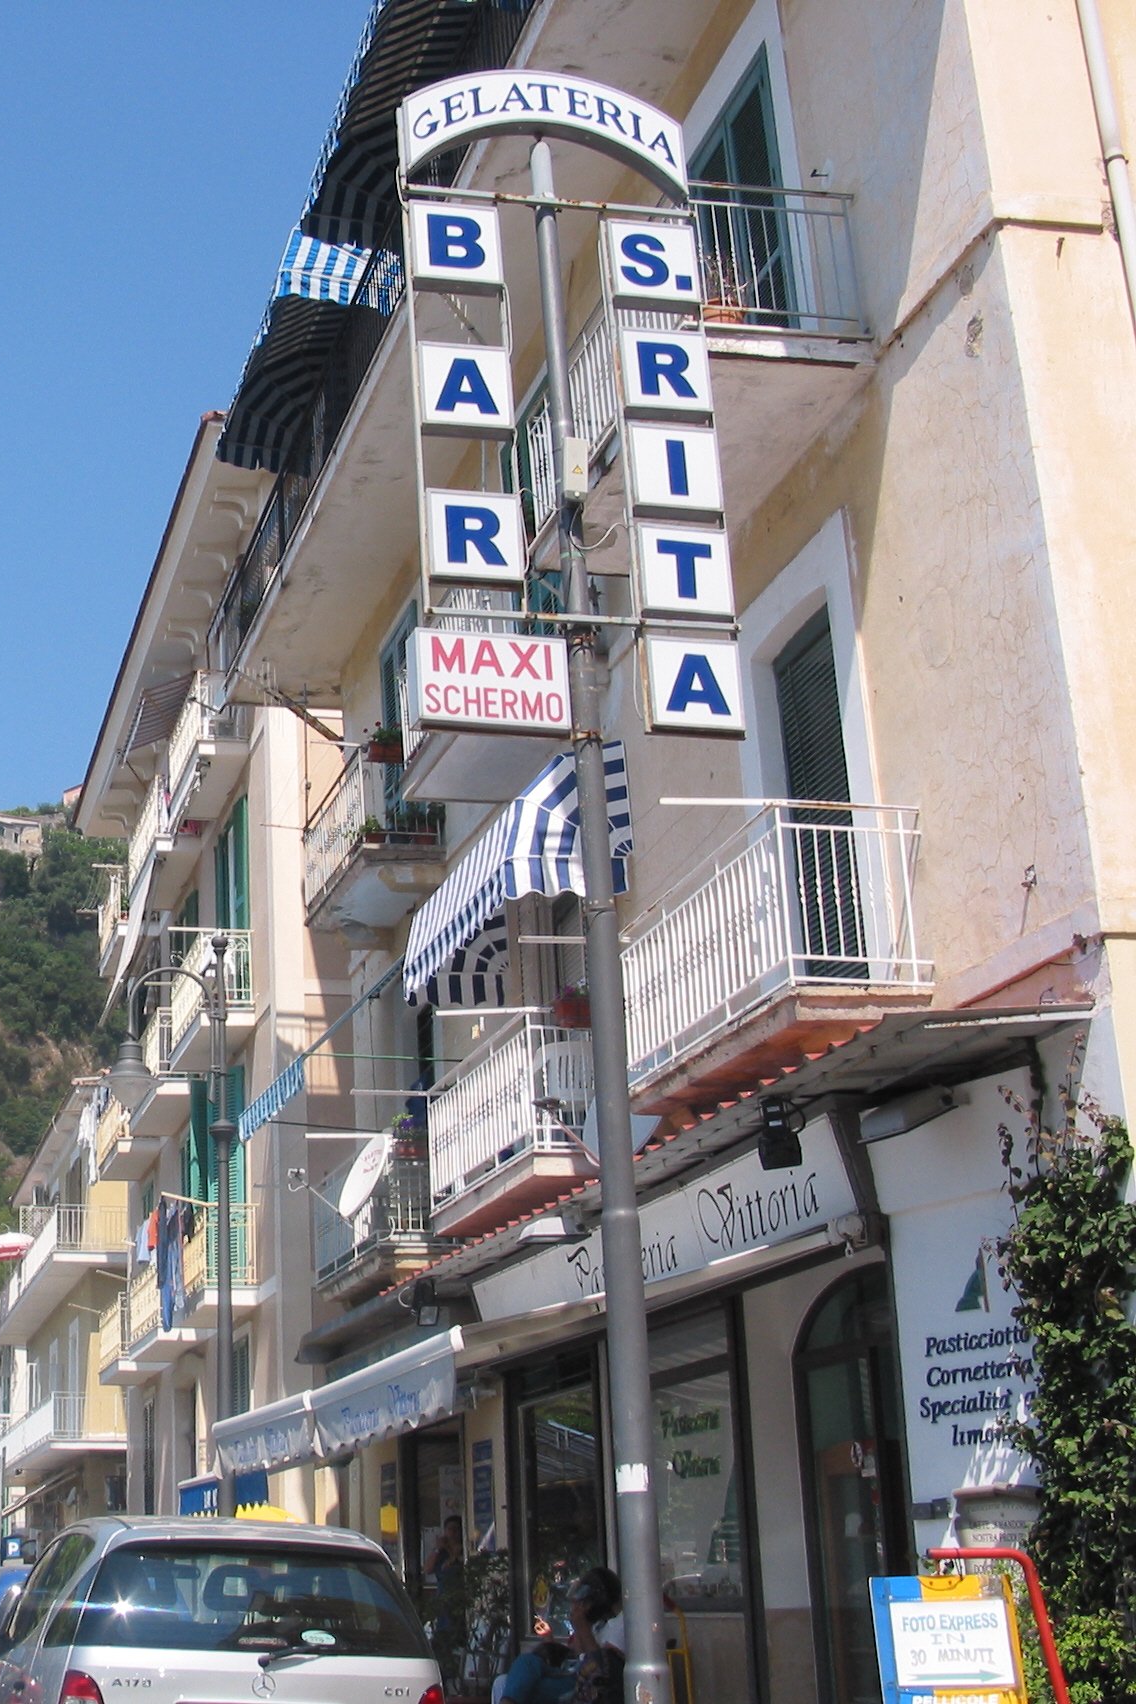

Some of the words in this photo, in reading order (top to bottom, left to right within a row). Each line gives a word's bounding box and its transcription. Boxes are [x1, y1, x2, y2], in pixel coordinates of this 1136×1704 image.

[413, 82, 678, 169] GELATERIA
[621, 233, 693, 291] S.
[427, 213, 509, 567] BAR
[636, 341, 732, 716] RITA
[431, 636, 554, 681] MAXI
[425, 683, 564, 722] SCHERMO
[697, 1170, 820, 1252] Vittoria
[8, 1542, 19, 1556] P
[902, 1615, 936, 1633] FOTO
[939, 1612, 999, 1632] EXPRESS
[931, 1633, 966, 1645] IN
[909, 1649, 927, 1667] 30
[937, 1648, 997, 1666] MINUTI
